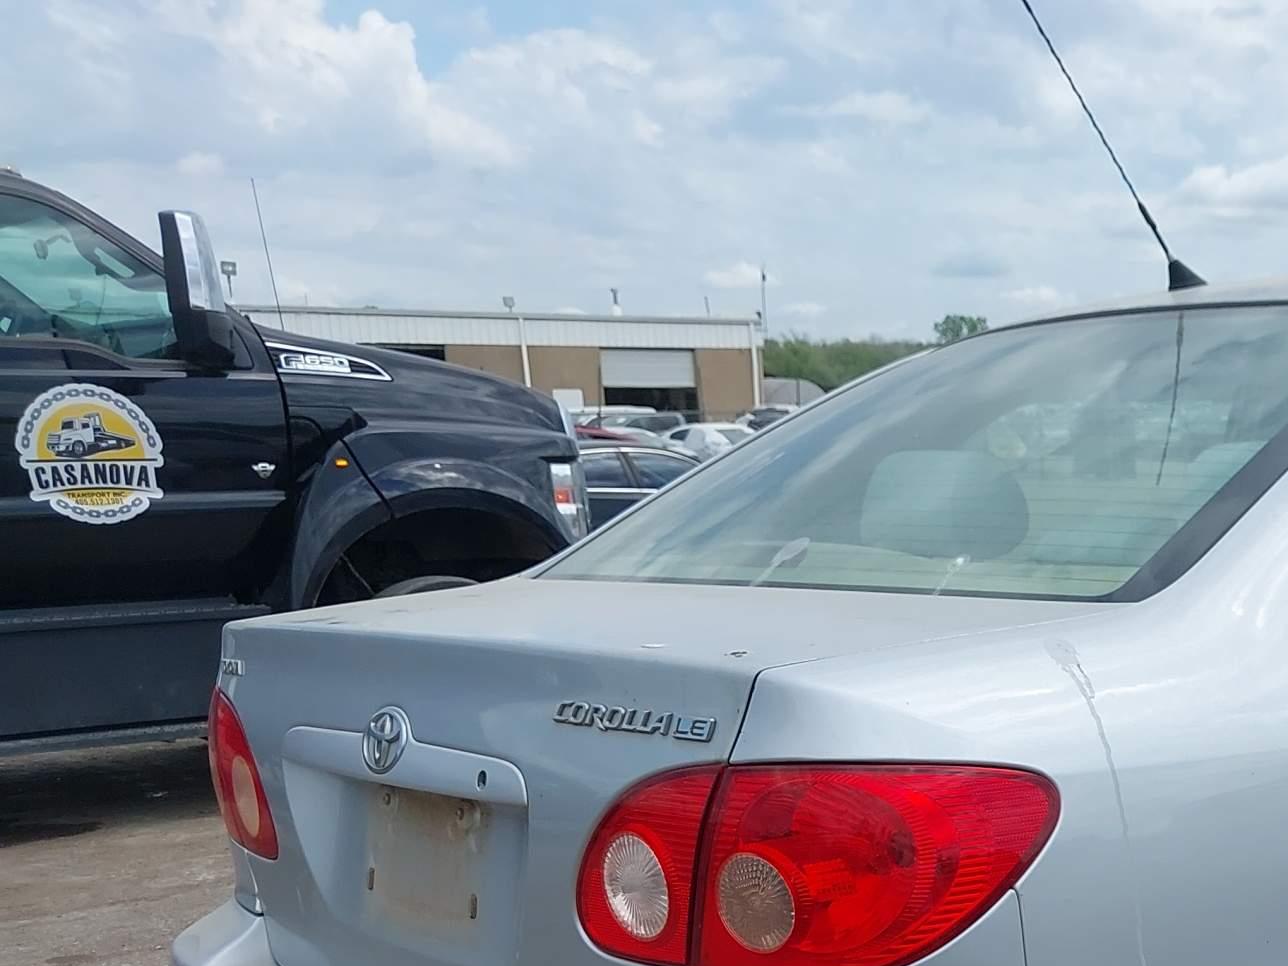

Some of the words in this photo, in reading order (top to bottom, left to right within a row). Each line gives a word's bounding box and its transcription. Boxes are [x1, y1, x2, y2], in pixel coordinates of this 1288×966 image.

[34, 463, 151, 489] CASANOVA
[553, 700, 674, 736] COROLLA
[674, 716, 717, 743] LE
